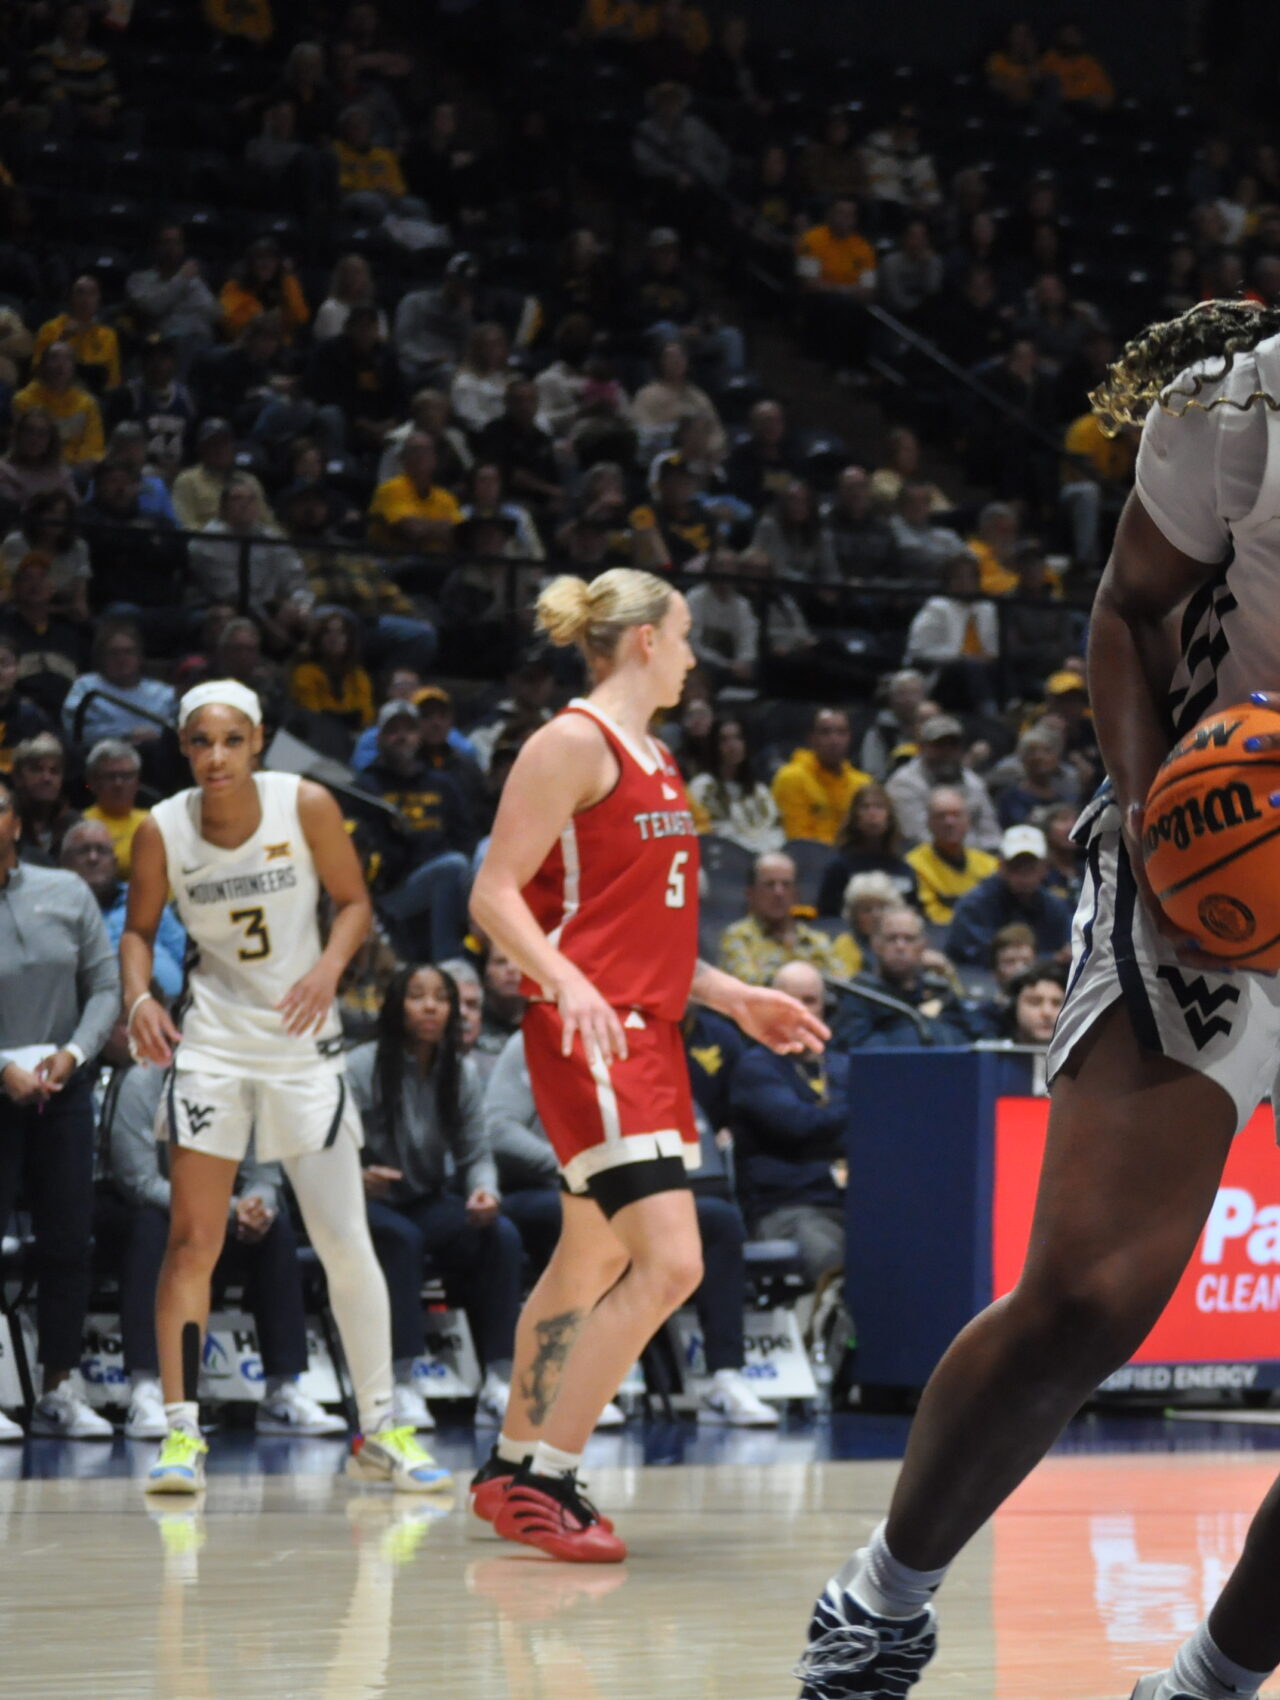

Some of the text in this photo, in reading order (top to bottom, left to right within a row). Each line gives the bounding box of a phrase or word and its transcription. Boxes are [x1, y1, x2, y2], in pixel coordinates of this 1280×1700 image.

[185, 866, 298, 905] MOUNTAINEERS
[664, 850, 689, 909] 5
[229, 905, 272, 963] 3
